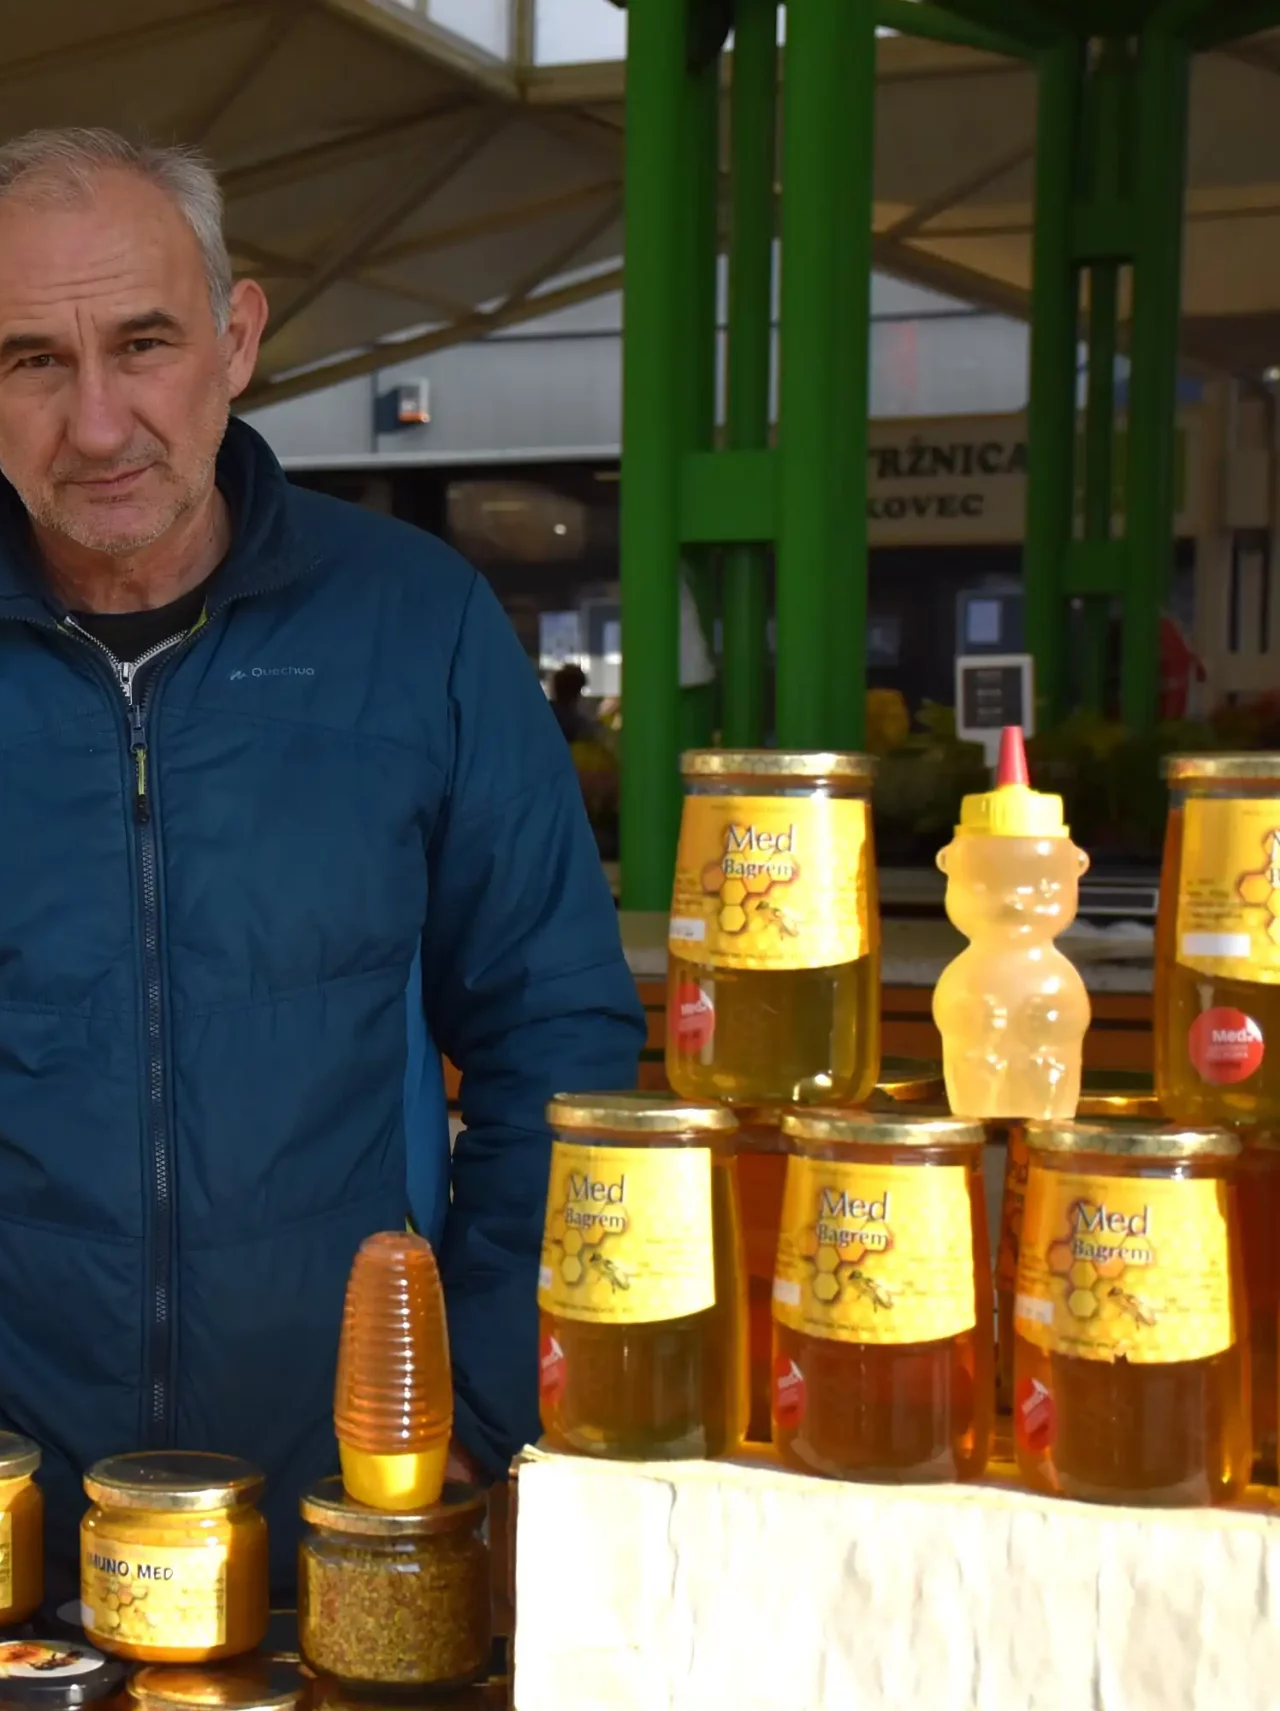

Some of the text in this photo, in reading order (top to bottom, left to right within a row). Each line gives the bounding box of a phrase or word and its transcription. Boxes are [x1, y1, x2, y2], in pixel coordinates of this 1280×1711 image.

[251, 665, 315, 677] Quechua
[727, 823, 795, 852] Med
[723, 858, 796, 877] Bagrem
[570, 1173, 625, 1203] Med
[821, 1188, 889, 1221] Med
[565, 1207, 626, 1229] Bagrem
[1076, 1202, 1150, 1236] Med
[816, 1222, 889, 1248] Bagrem
[1073, 1240, 1152, 1264] Bagrem
[137, 1563, 173, 1581] MED
